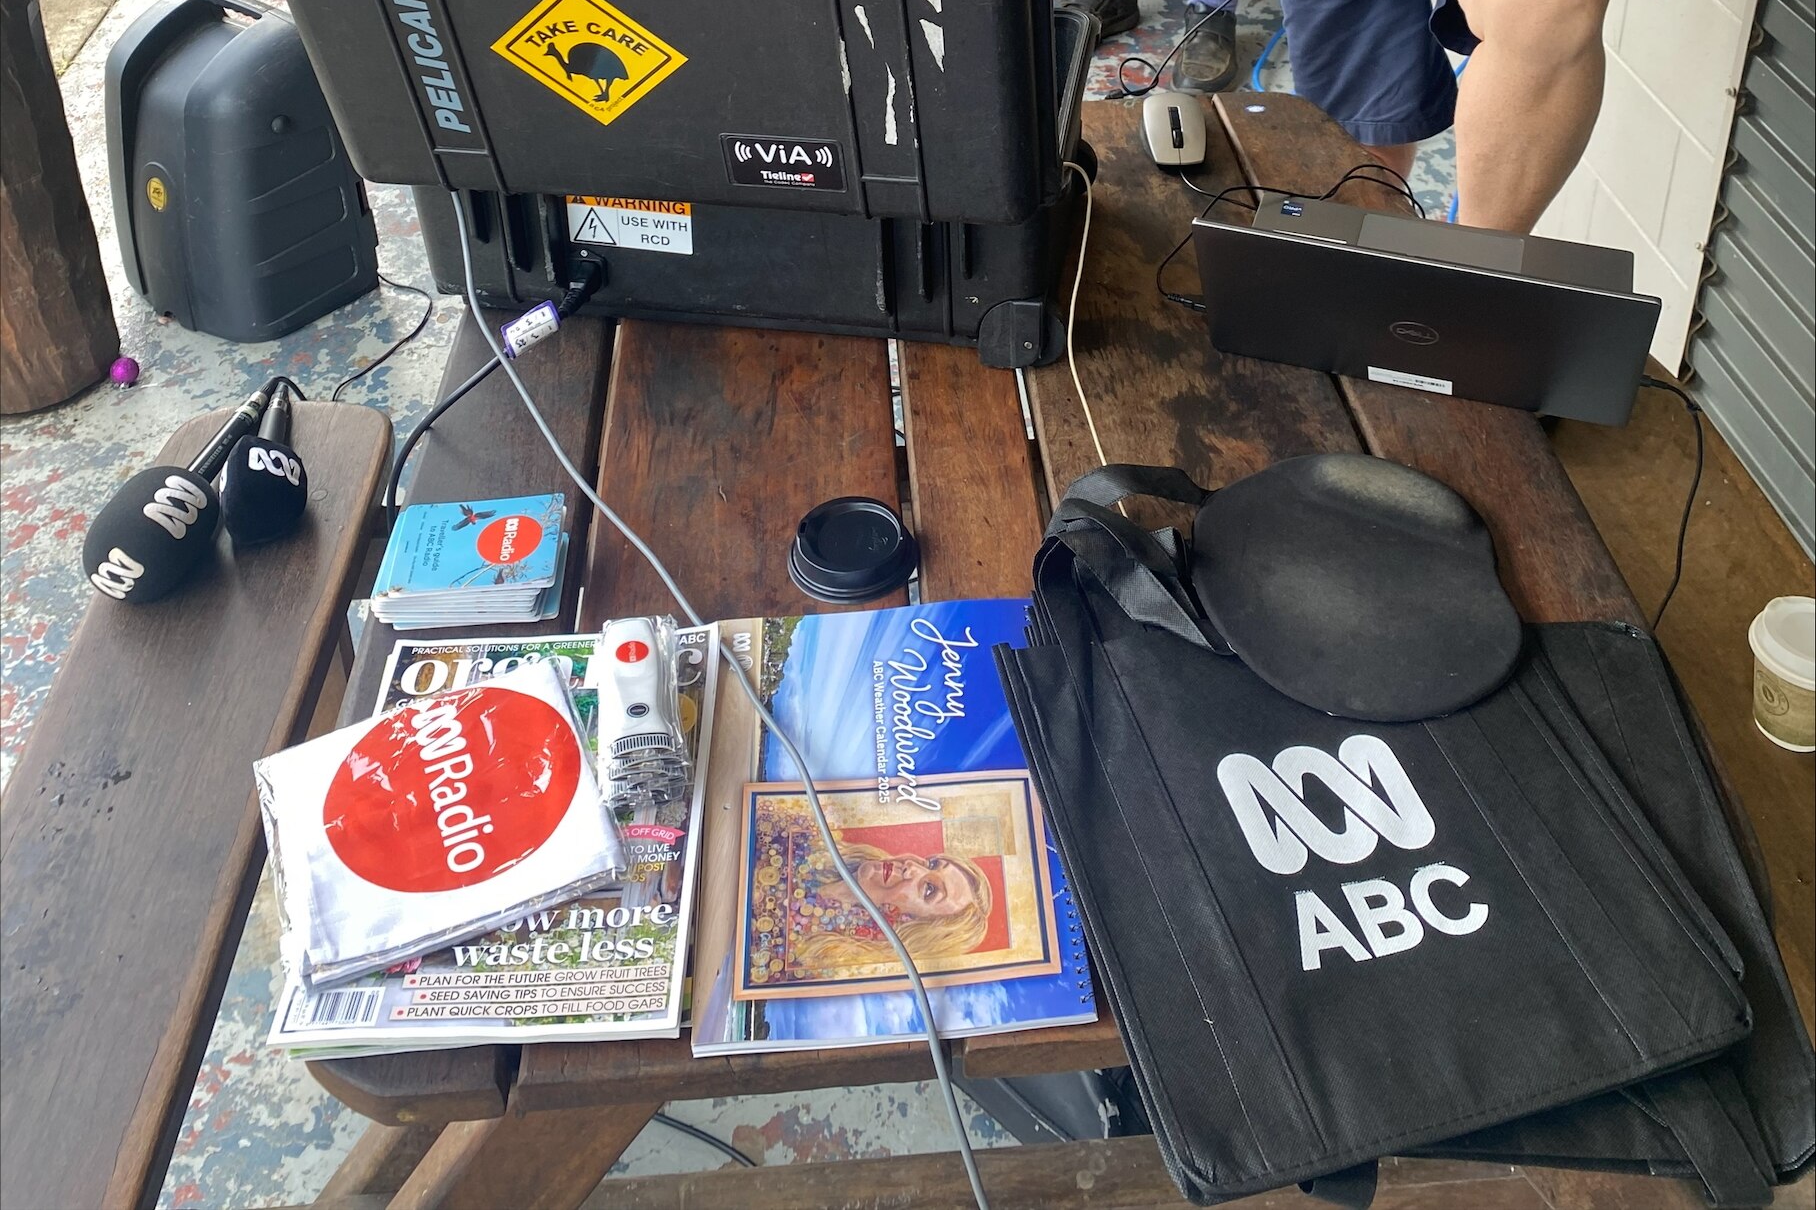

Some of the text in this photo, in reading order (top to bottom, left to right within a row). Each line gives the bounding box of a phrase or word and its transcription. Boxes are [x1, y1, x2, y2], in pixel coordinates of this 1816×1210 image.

[524, 20, 650, 56] TAKE CARE
[754, 142, 812, 165] ViA
[760, 170, 802, 181] Tieline
[595, 197, 686, 215] WARNING
[621, 216, 688, 232] USE WITH
[641, 234, 670, 246] RCD
[427, 533, 436, 548] ABC
[431, 519, 450, 572] Traveller's guide
[500, 531, 517, 561] Radio
[422, 547, 433, 567] Radio
[411, 646, 463, 655] PRACTICAL
[465, 644, 519, 653] SOLUTIONS
[521, 643, 541, 651] FOR
[543, 642, 550, 650] A
[679, 633, 706, 644] ABC
[910, 618, 979, 724] Jenny
[872, 660, 891, 804] ABC Weather Calendar 2025
[887, 647, 942, 812] Woodward
[424, 753, 494, 873] Radio
[631, 827, 651, 836] OFF
[651, 829, 675, 840] GRID
[630, 843, 670, 853] TO LIVE
[637, 851, 680, 863] MONEY
[565, 903, 674, 931] more
[1294, 861, 1489, 971] ABC
[452, 931, 655, 967] waste less
[419, 965, 667, 986] PLAN FOR THE FUTURE GROW FRUIT TREES
[429, 981, 665, 1001] SEED SAVING TIPS TO ENSURE SUCCESS
[407, 998, 663, 1017] PLANT QUICK CROPS TO FILL FOOD GAPS
